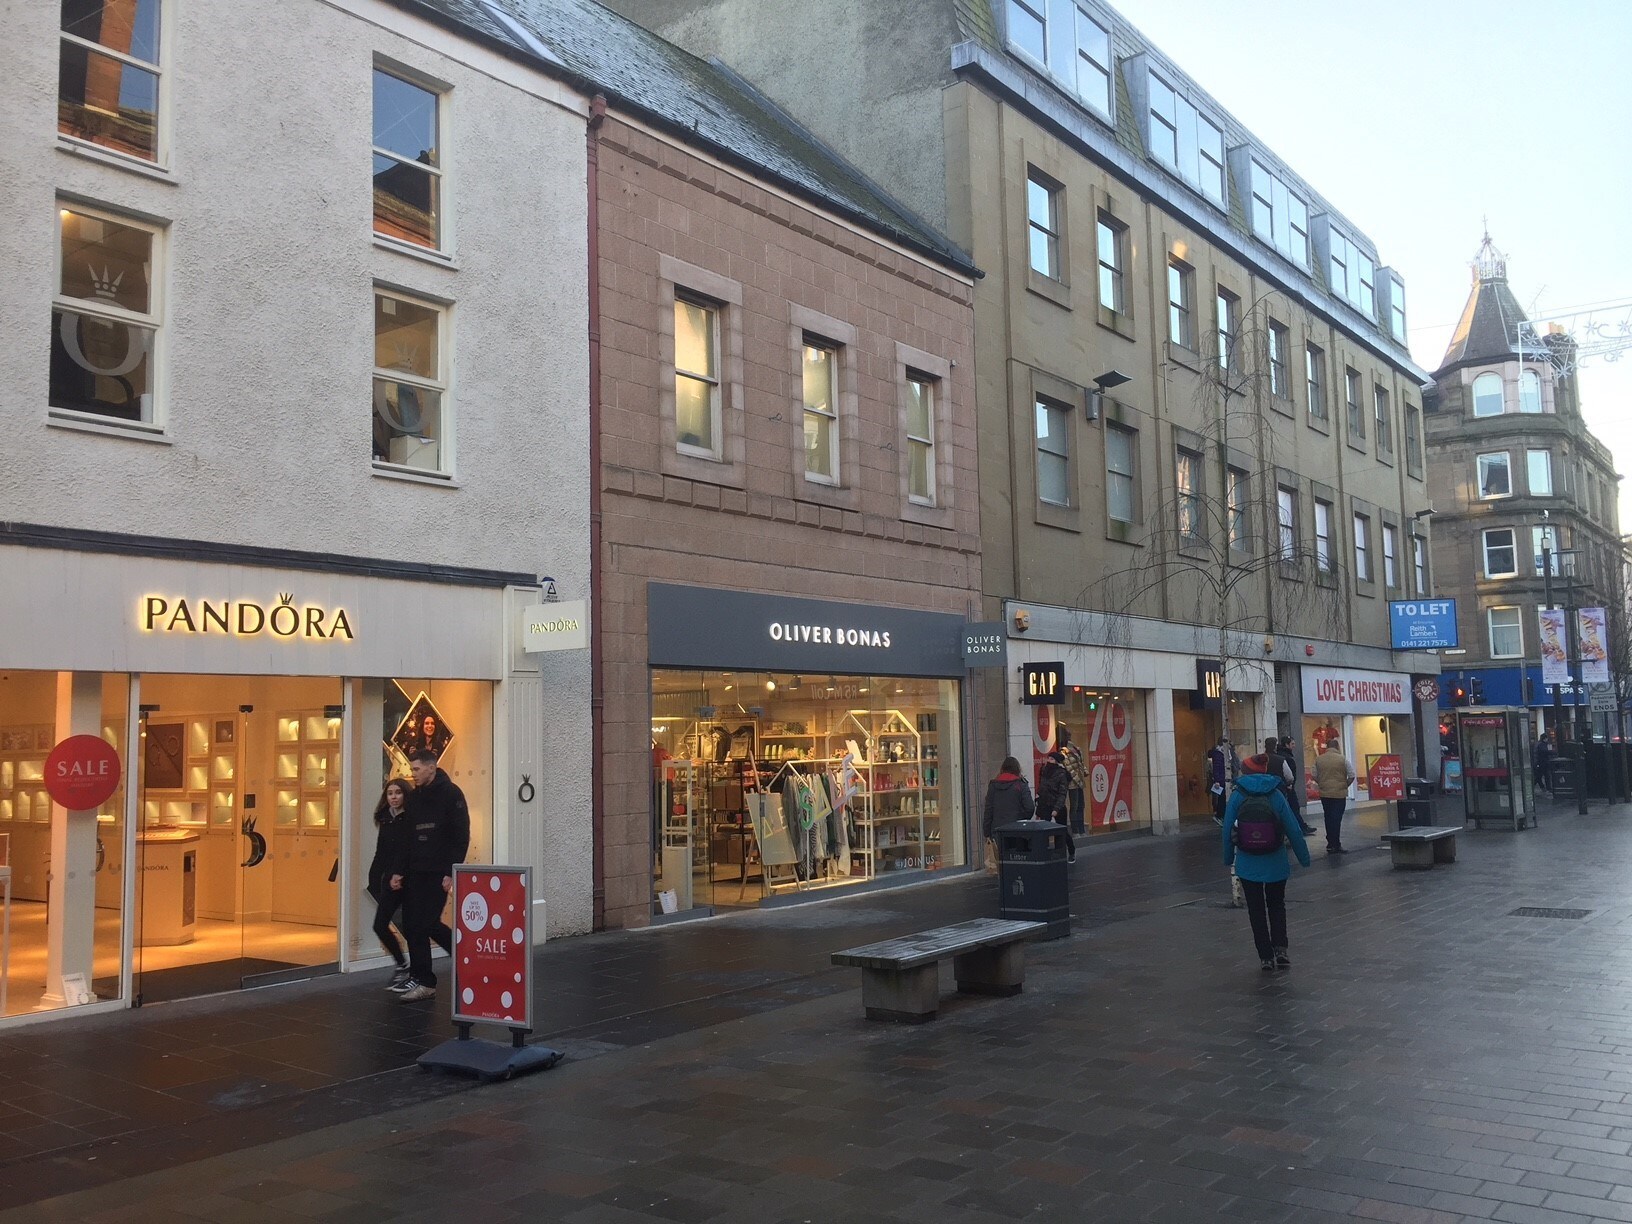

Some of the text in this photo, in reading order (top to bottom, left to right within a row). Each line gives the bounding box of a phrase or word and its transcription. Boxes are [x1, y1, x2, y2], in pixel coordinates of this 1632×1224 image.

[1395, 603, 1450, 616] TO LET
[146, 595, 353, 639] PANDORA
[530, 618, 579, 634] PANDORA
[769, 622, 891, 648] OLIVER BONAS
[966, 635, 1001, 645] OLIVER
[967, 645, 1001, 654] BONAS
[1029, 671, 1057, 696] GAP
[1417, 680, 1434, 688] COSTA
[1316, 679, 1402, 703] LOVE CHRISTMAS
[57, 760, 109, 776] SALE
[1373, 777, 1401, 788] £14.99
[1116, 809, 1127, 818] OFF
[904, 855, 935, 868] JOIN US
[465, 910, 484, 922] 50%
[476, 937, 507, 954] SALE
